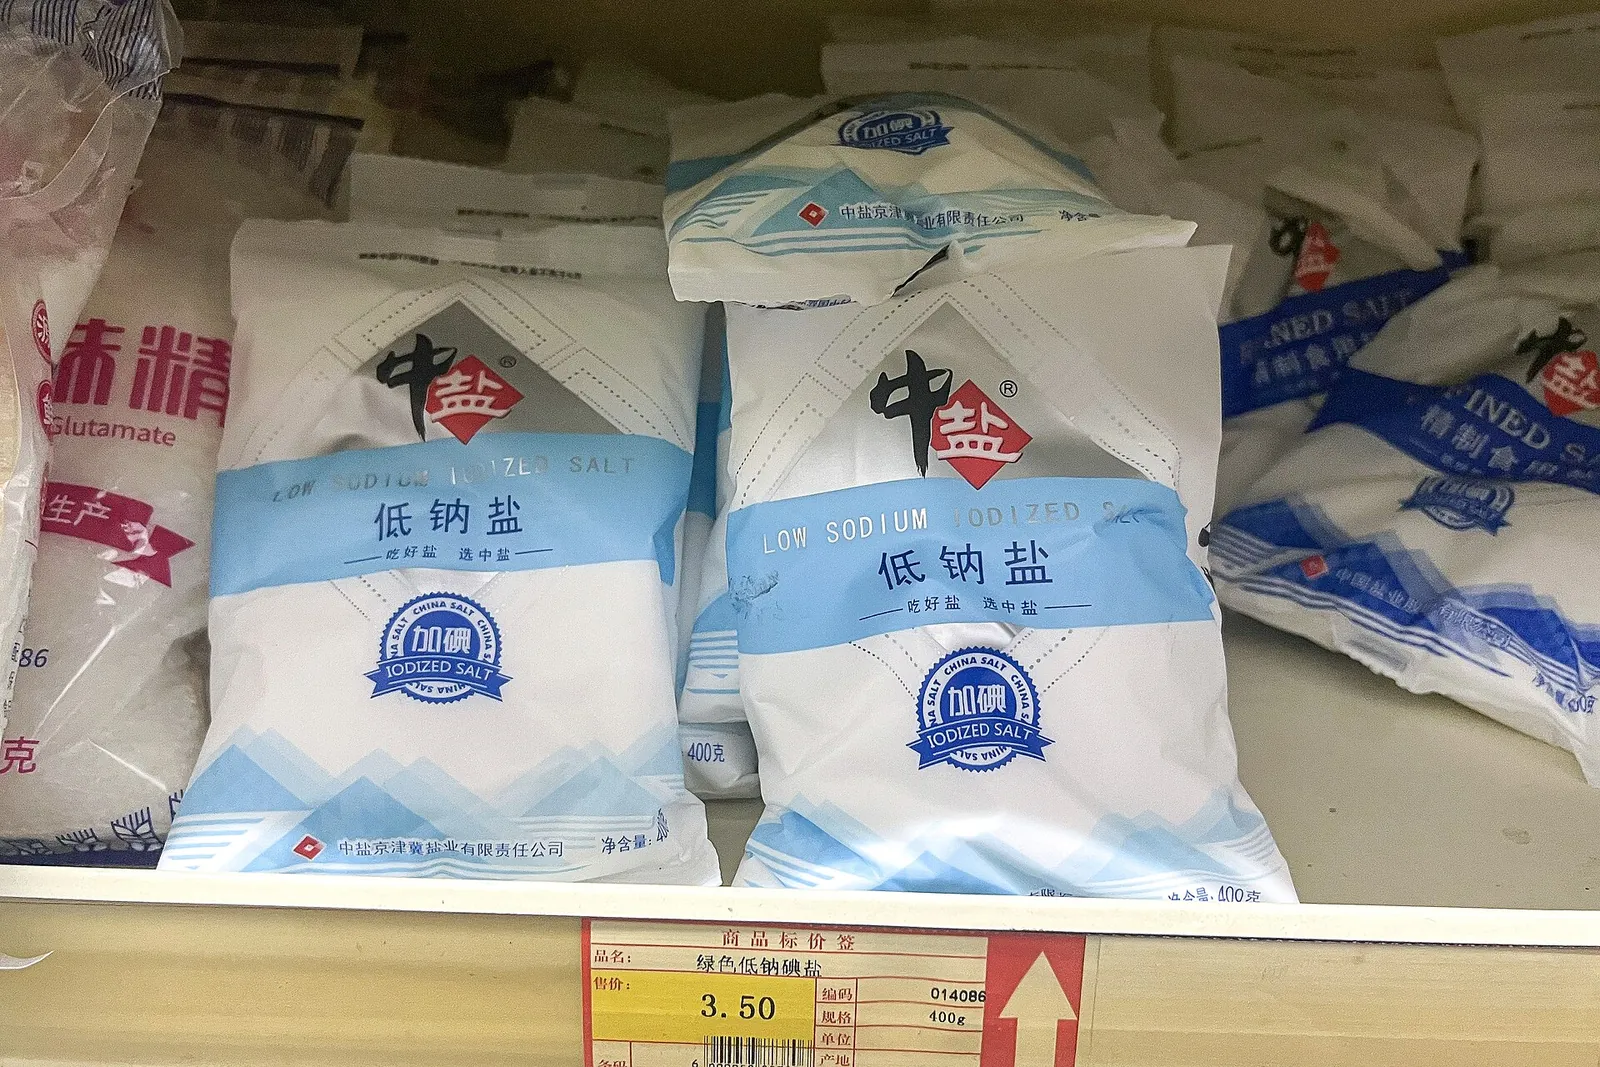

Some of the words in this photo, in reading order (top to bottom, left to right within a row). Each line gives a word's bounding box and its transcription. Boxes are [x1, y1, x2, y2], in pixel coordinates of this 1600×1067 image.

[904, 128, 937, 144] SALT
[376, 333, 512, 442] 中盐
[869, 350, 1023, 478] 中盐
[51, 416, 176, 447] Glutamate
[571, 456, 635, 475] SALT
[46, 494, 112, 526] 生产
[374, 495, 523, 541] 低钠盐
[763, 526, 808, 554] LOW
[826, 508, 928, 544] SODIUM
[954, 502, 1080, 528] IODIZED
[386, 545, 437, 561] 吃好盐
[458, 547, 510, 562] 选中盐
[877, 540, 1053, 590] 低钠盐
[412, 600, 447, 616] CHINA
[450, 601, 475, 617] SALT
[906, 595, 961, 614] 吃好盐
[982, 596, 1038, 616] 选中盐
[411, 625, 472, 654] 加碘
[386, 660, 451, 678] IODIZED
[456, 662, 494, 681] SALT
[944, 656, 977, 676] CHINA
[980, 656, 1007, 673] SALT
[948, 684, 1007, 717] 加碘
[926, 723, 990, 749] IODIZED
[994, 724, 1034, 741] SALT
[0, 736, 40, 774] 克
[687, 742, 725, 763] 400克
[339, 839, 564, 859] 中盐京津冀盐业有限责任公司
[722, 929, 856, 951] 商品标价签
[594, 949, 631, 964] 品名:
[697, 953, 822, 978] 绿色低钠碘盐
[822, 987, 853, 1001] 编码
[931, 987, 987, 1003] 014086
[700, 993, 777, 1021] 3.50
[821, 1010, 852, 1025] 规格
[929, 1010, 966, 1026] 400g
[821, 1032, 851, 1047] 单位
[818, 1053, 850, 1067] 产地
